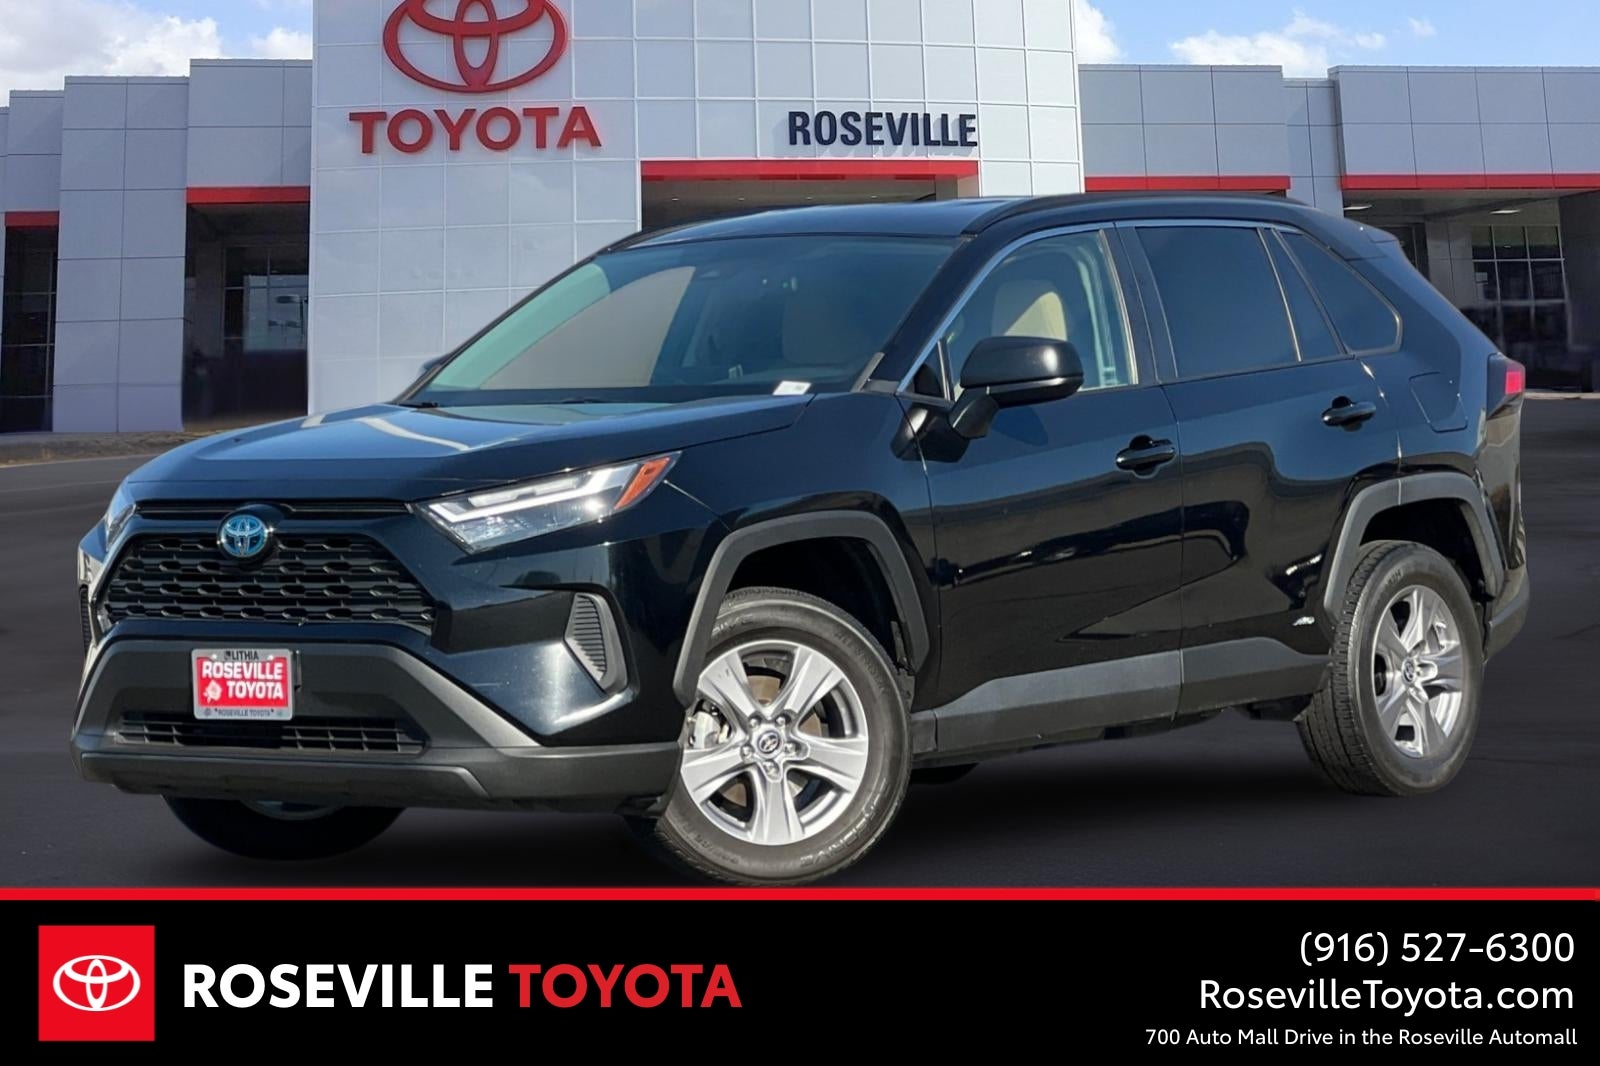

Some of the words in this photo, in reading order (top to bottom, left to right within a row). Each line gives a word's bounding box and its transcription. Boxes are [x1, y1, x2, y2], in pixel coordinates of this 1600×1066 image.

[349, 106, 602, 154] TOYOTA
[788, 110, 978, 147] ROSEVILLE
[231, 650, 260, 661] LITHIA
[202, 660, 283, 680] ROSEVILLE
[226, 680, 283, 699] TOYOTA
